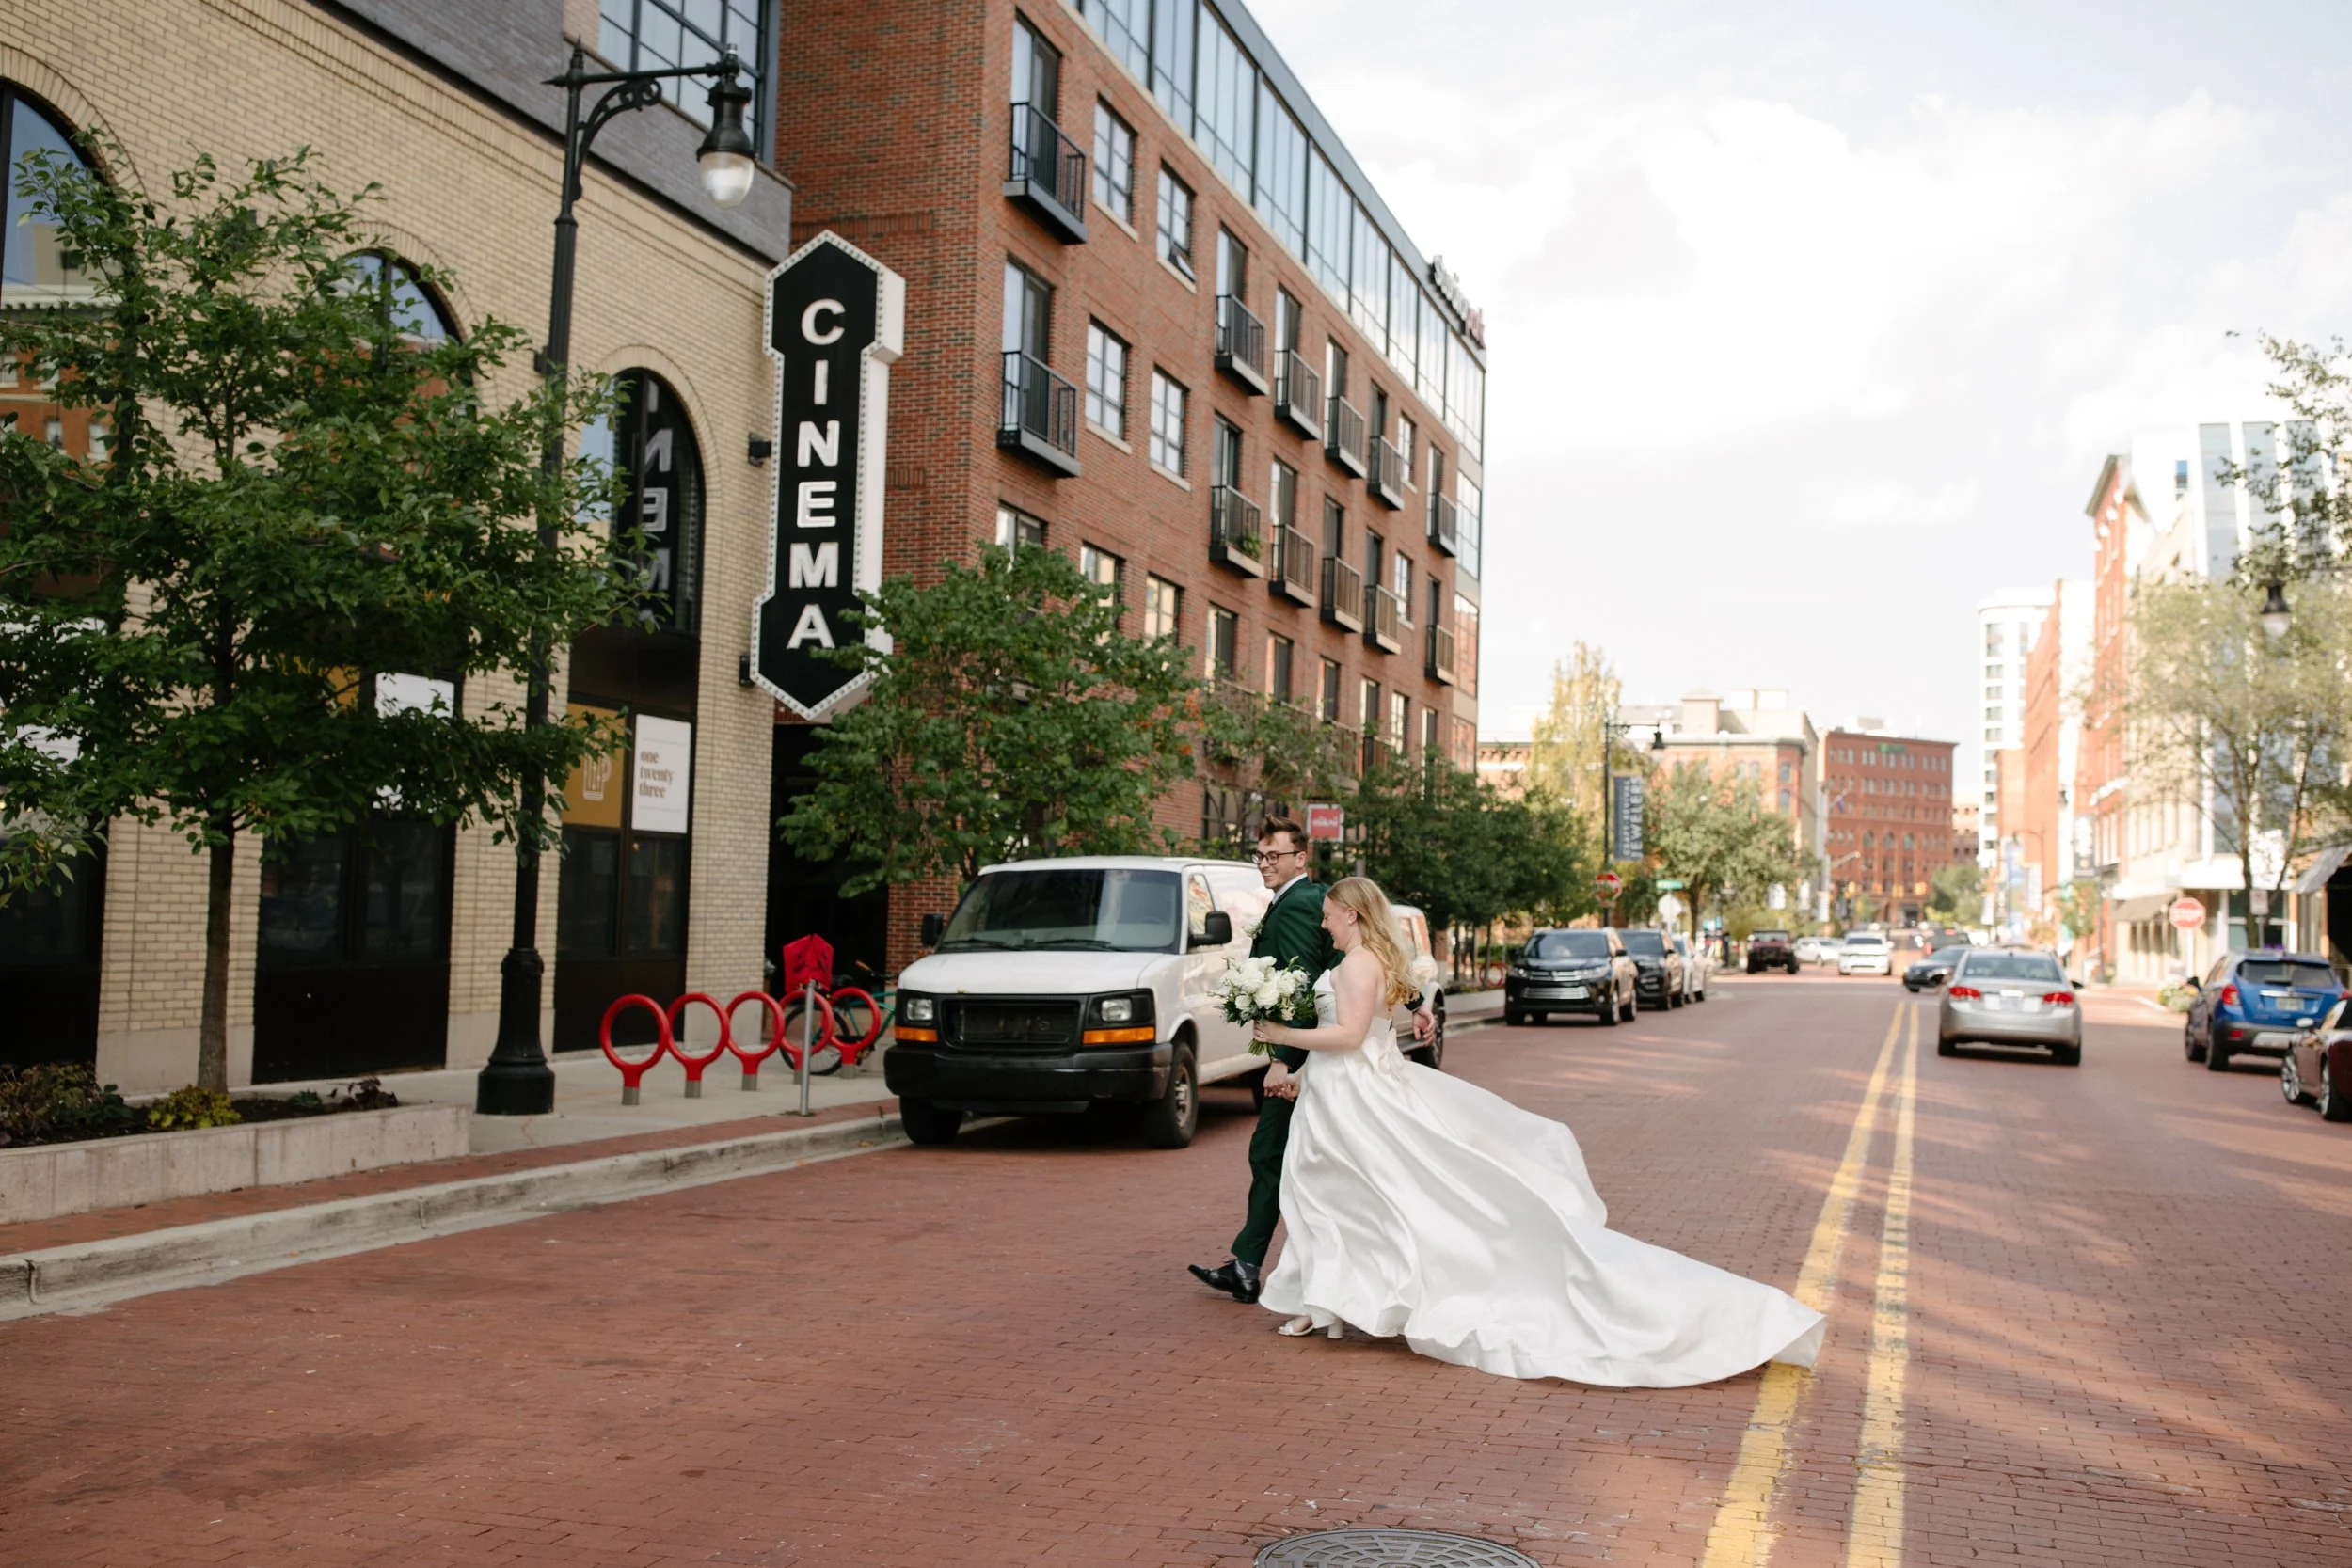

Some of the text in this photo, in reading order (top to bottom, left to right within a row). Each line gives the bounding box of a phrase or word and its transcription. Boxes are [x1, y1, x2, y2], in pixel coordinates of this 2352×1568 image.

[787, 298, 846, 650] CINEMA
[640, 751, 659, 764] one
[639, 766, 675, 785] twenty
[638, 782, 666, 799] three
[1629, 776, 1644, 858] JEWELERS
